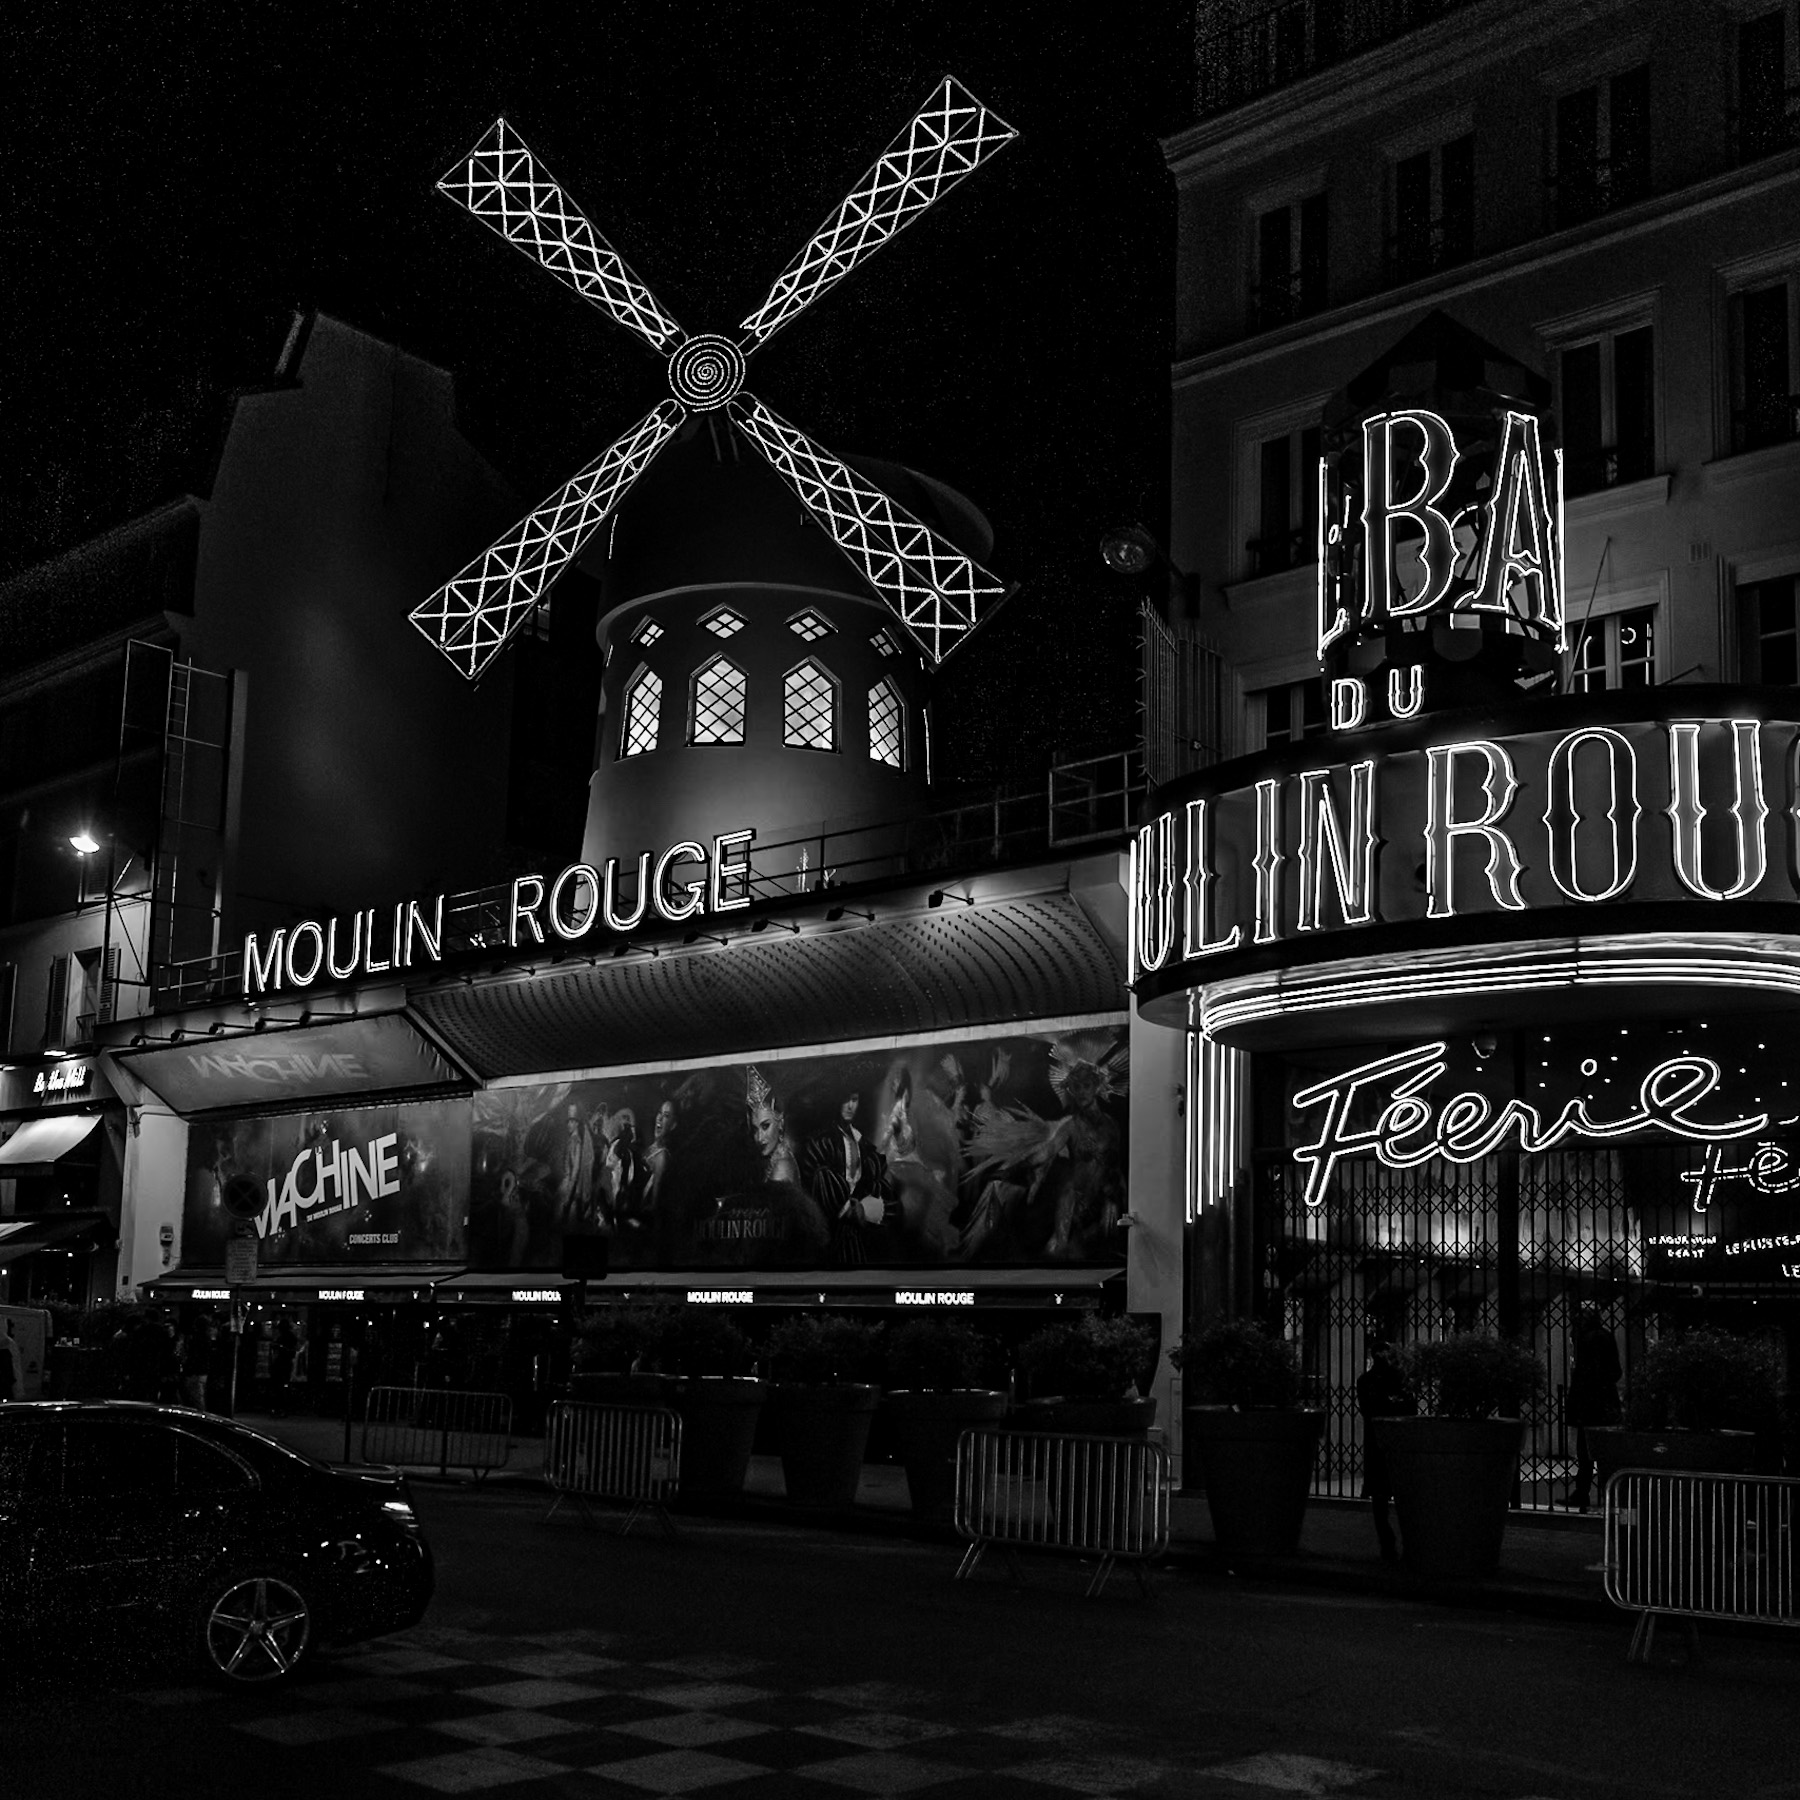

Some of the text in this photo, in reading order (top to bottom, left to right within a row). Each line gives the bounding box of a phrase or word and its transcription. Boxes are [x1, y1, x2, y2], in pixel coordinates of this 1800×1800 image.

[1331, 663, 1424, 730] DU
[1424, 719, 1800, 918] ROU
[242, 828, 757, 995] MOULIN ROUGE
[1293, 1042, 1768, 1207] Féerie
[349, 1232, 399, 1245] CONCERTS CLUB
[687, 1291, 754, 1304] MOULIN ROUGE
[895, 1291, 975, 1306] MOULIN ROUGE
